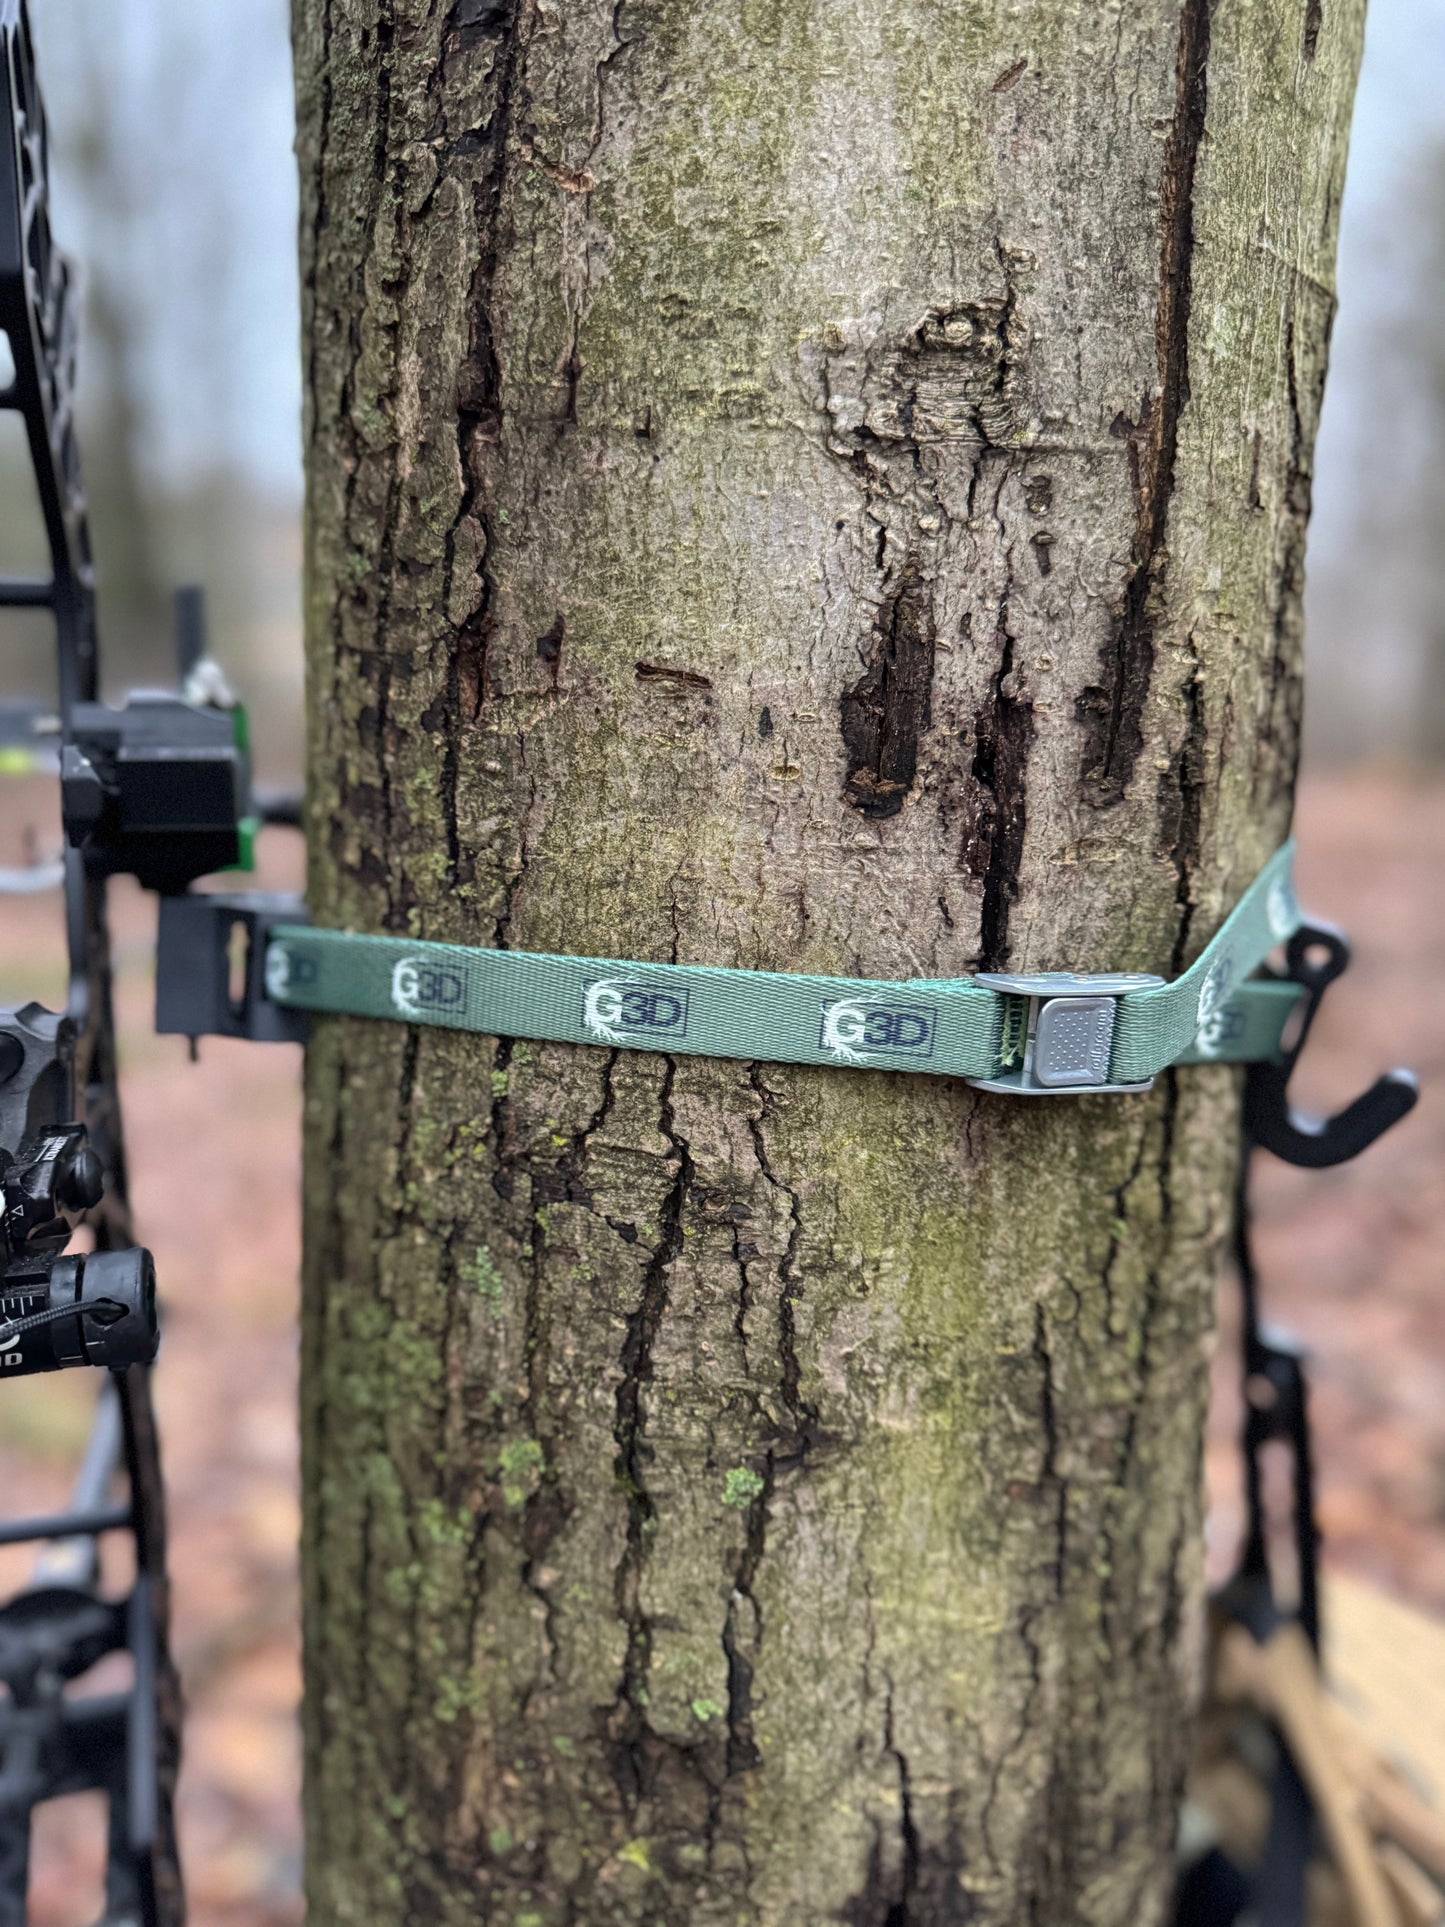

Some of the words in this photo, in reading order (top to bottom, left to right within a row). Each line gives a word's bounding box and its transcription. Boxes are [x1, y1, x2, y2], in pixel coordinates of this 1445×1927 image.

[392, 962, 463, 1011] G3D
[584, 984, 684, 1034] G3D
[824, 1001, 931, 1050] G3D
[0, 1353, 23, 1367] D
